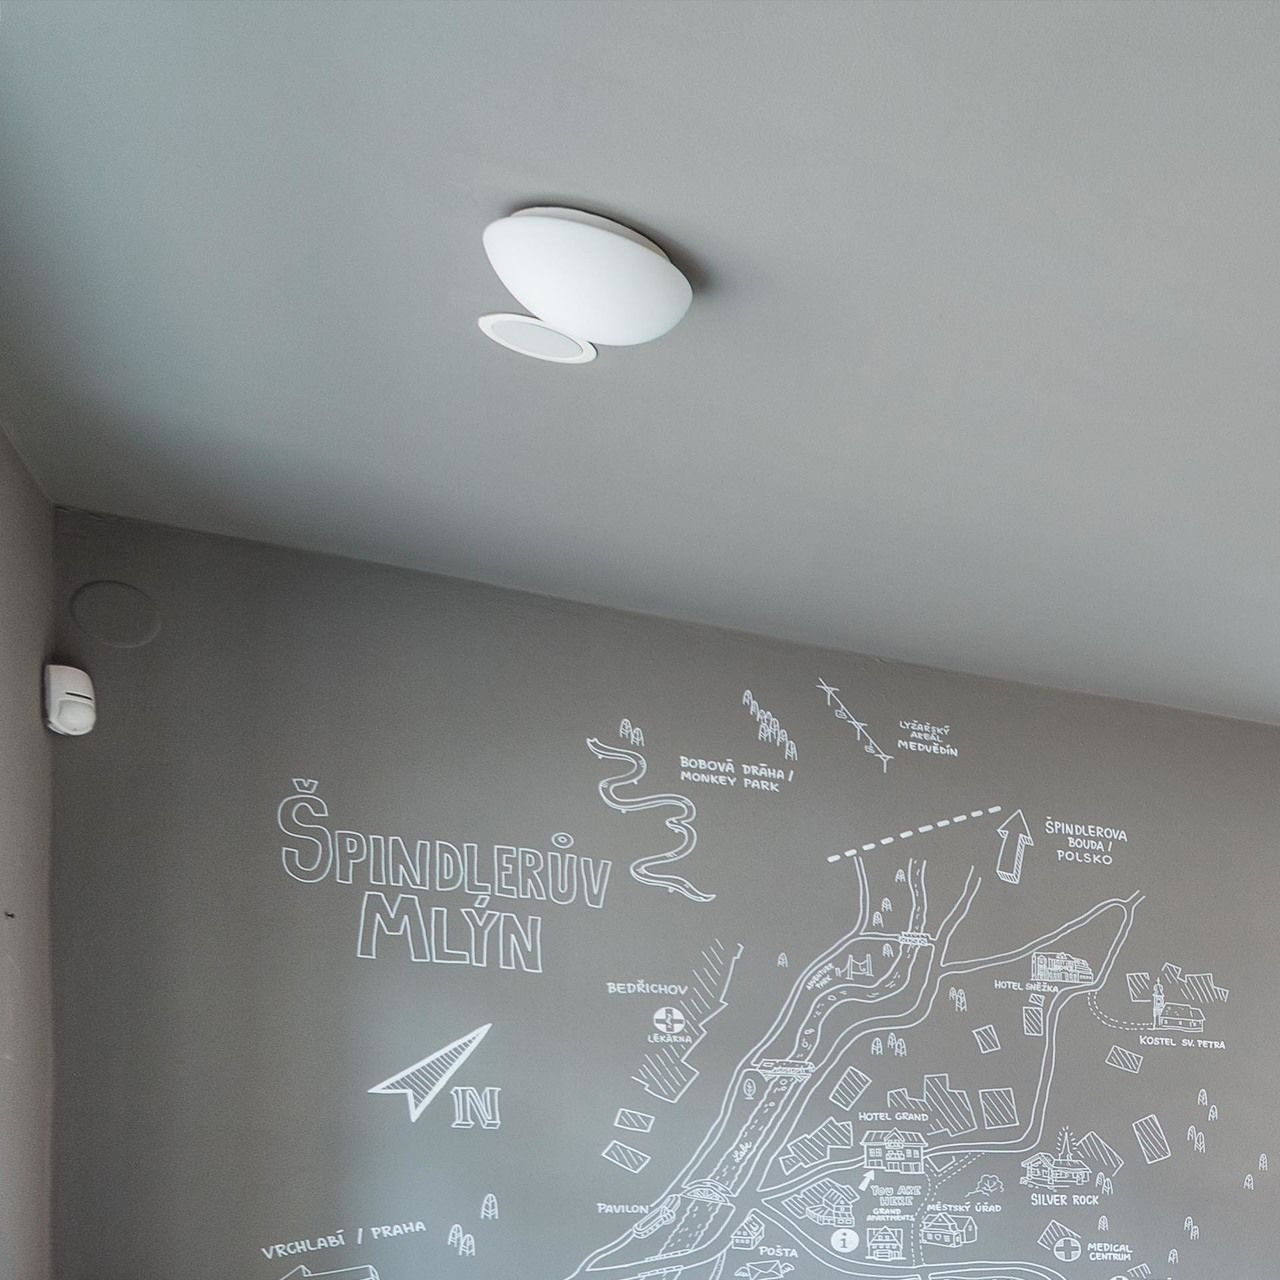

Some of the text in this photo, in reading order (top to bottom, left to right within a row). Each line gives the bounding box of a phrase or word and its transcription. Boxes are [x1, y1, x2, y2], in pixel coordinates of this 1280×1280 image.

[681, 771, 780, 793] MONKEY PARK
[1045, 816, 1128, 842] ŠPINDLEROVA
[277, 778, 612, 909] ŠPINDLERŮV
[1067, 836, 1105, 852] BOUDA
[1057, 849, 1113, 865] POLSKO
[357, 891, 543, 973] MLÝN
[606, 979, 689, 995] BEDŘICHOV
[817, 974, 833, 989] PARK
[994, 979, 1023, 991] HOTEL
[1139, 1035, 1176, 1047] KOSTEL
[1197, 1039, 1226, 1050] PETRA
[450, 1087, 501, 1129] N
[858, 1111, 929, 1122] HOTEL GRAND
[1031, 1193, 1099, 1206] SILVER ROCK
[597, 1203, 649, 1214] PAVILON
[371, 1221, 427, 1240] PRAHA
[758, 1244, 799, 1258] POŠTA
[1087, 1242, 1133, 1253] MEDICAL
[1089, 1252, 1132, 1261] CENTRUM
